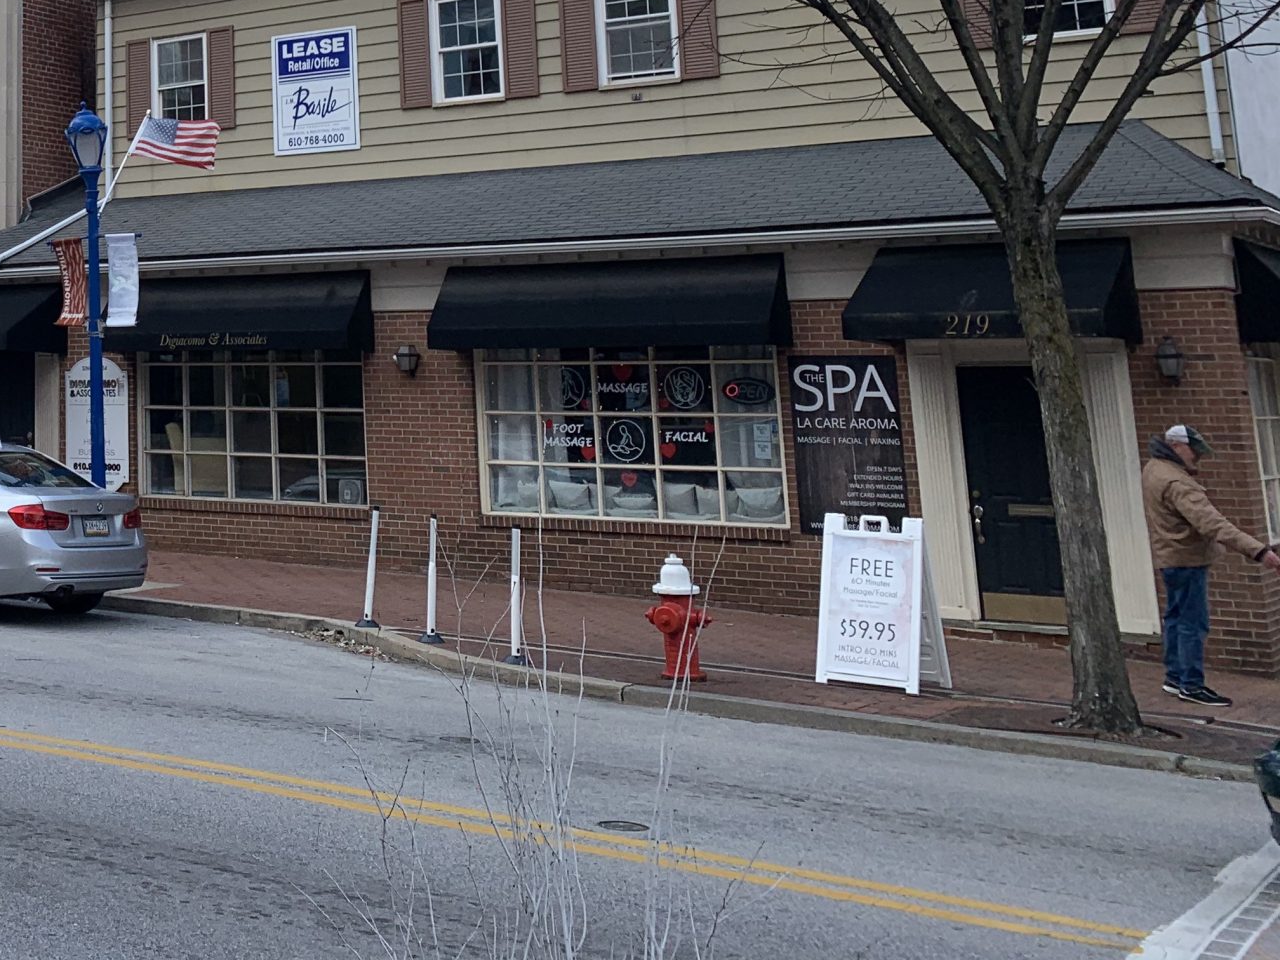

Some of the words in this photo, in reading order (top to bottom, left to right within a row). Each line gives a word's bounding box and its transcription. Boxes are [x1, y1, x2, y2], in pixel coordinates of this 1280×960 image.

[282, 37, 345, 59] LEASE
[288, 57, 340, 72] Retail/Office
[292, 86, 352, 130] Basile
[288, 133, 345, 147] 610-768-4000
[56, 246, 71, 313] PHOENIXVILLE
[945, 314, 989, 335] 219
[208, 332, 220, 345] &
[221, 331, 267, 345] Associates
[804, 373, 825, 383] THE
[597, 381, 648, 393] MASSAGE
[726, 383, 769, 399] OPEN
[793, 364, 896, 413] SPA
[553, 423, 584, 434] FOOT
[797, 417, 812, 429] LA
[815, 417, 846, 429] CARE
[849, 418, 899, 430] AROMA
[544, 436, 593, 448] MASSAGE
[665, 431, 709, 443] FACIAL
[797, 436, 831, 444] MASSAGE
[838, 437, 863, 445] FACIAL
[870, 437, 901, 446] WAXING
[849, 557, 894, 578] FREE
[851, 577, 863, 585] 60
[843, 586, 898, 599] Massage/Facial
[840, 618, 896, 642] $59.95
[838, 644, 863, 654] INTRO
[864, 646, 877, 656] 60
[879, 647, 897, 658] MINS
[834, 654, 900, 669] MASSAGE/FACIAL
